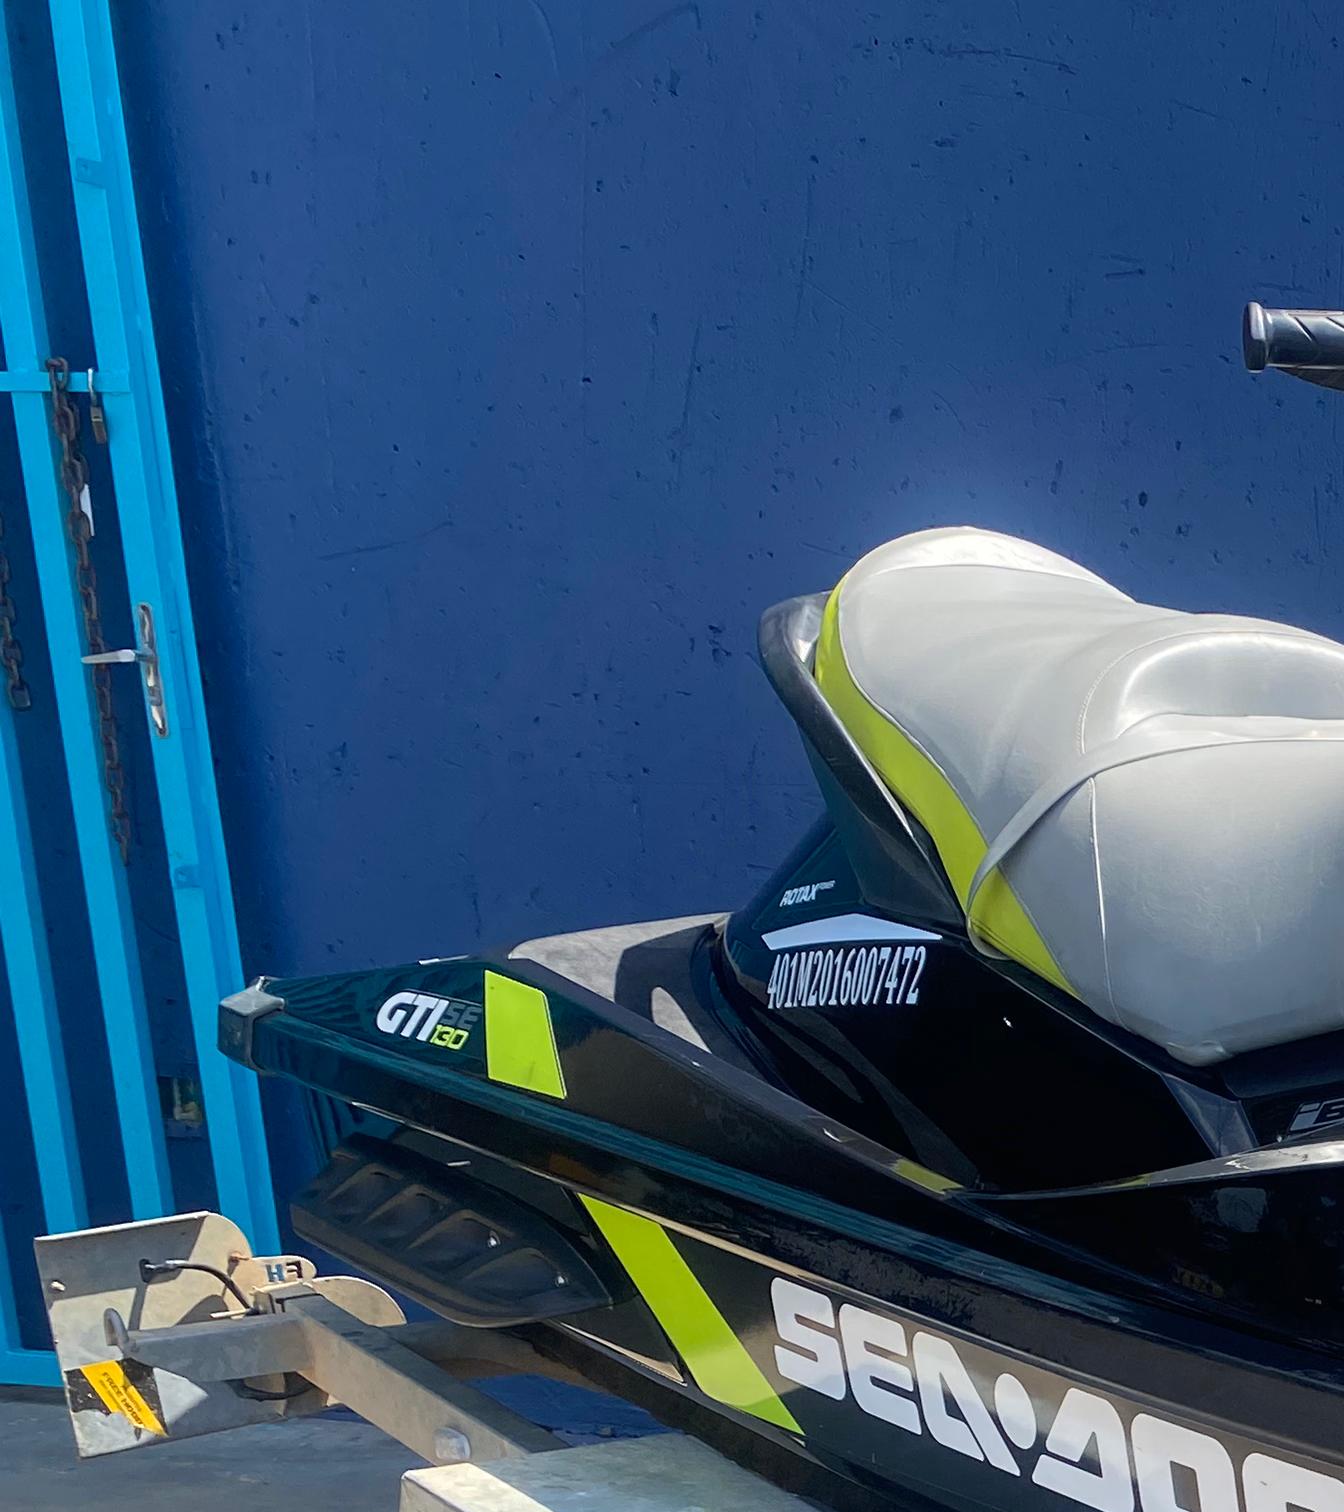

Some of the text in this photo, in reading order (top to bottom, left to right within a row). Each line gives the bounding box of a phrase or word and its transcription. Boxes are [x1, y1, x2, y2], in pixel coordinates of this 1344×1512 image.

[766, 945, 927, 1010] 401M2016007472
[376, 991, 483, 1042] GTI SE
[428, 1023, 470, 1051] 130
